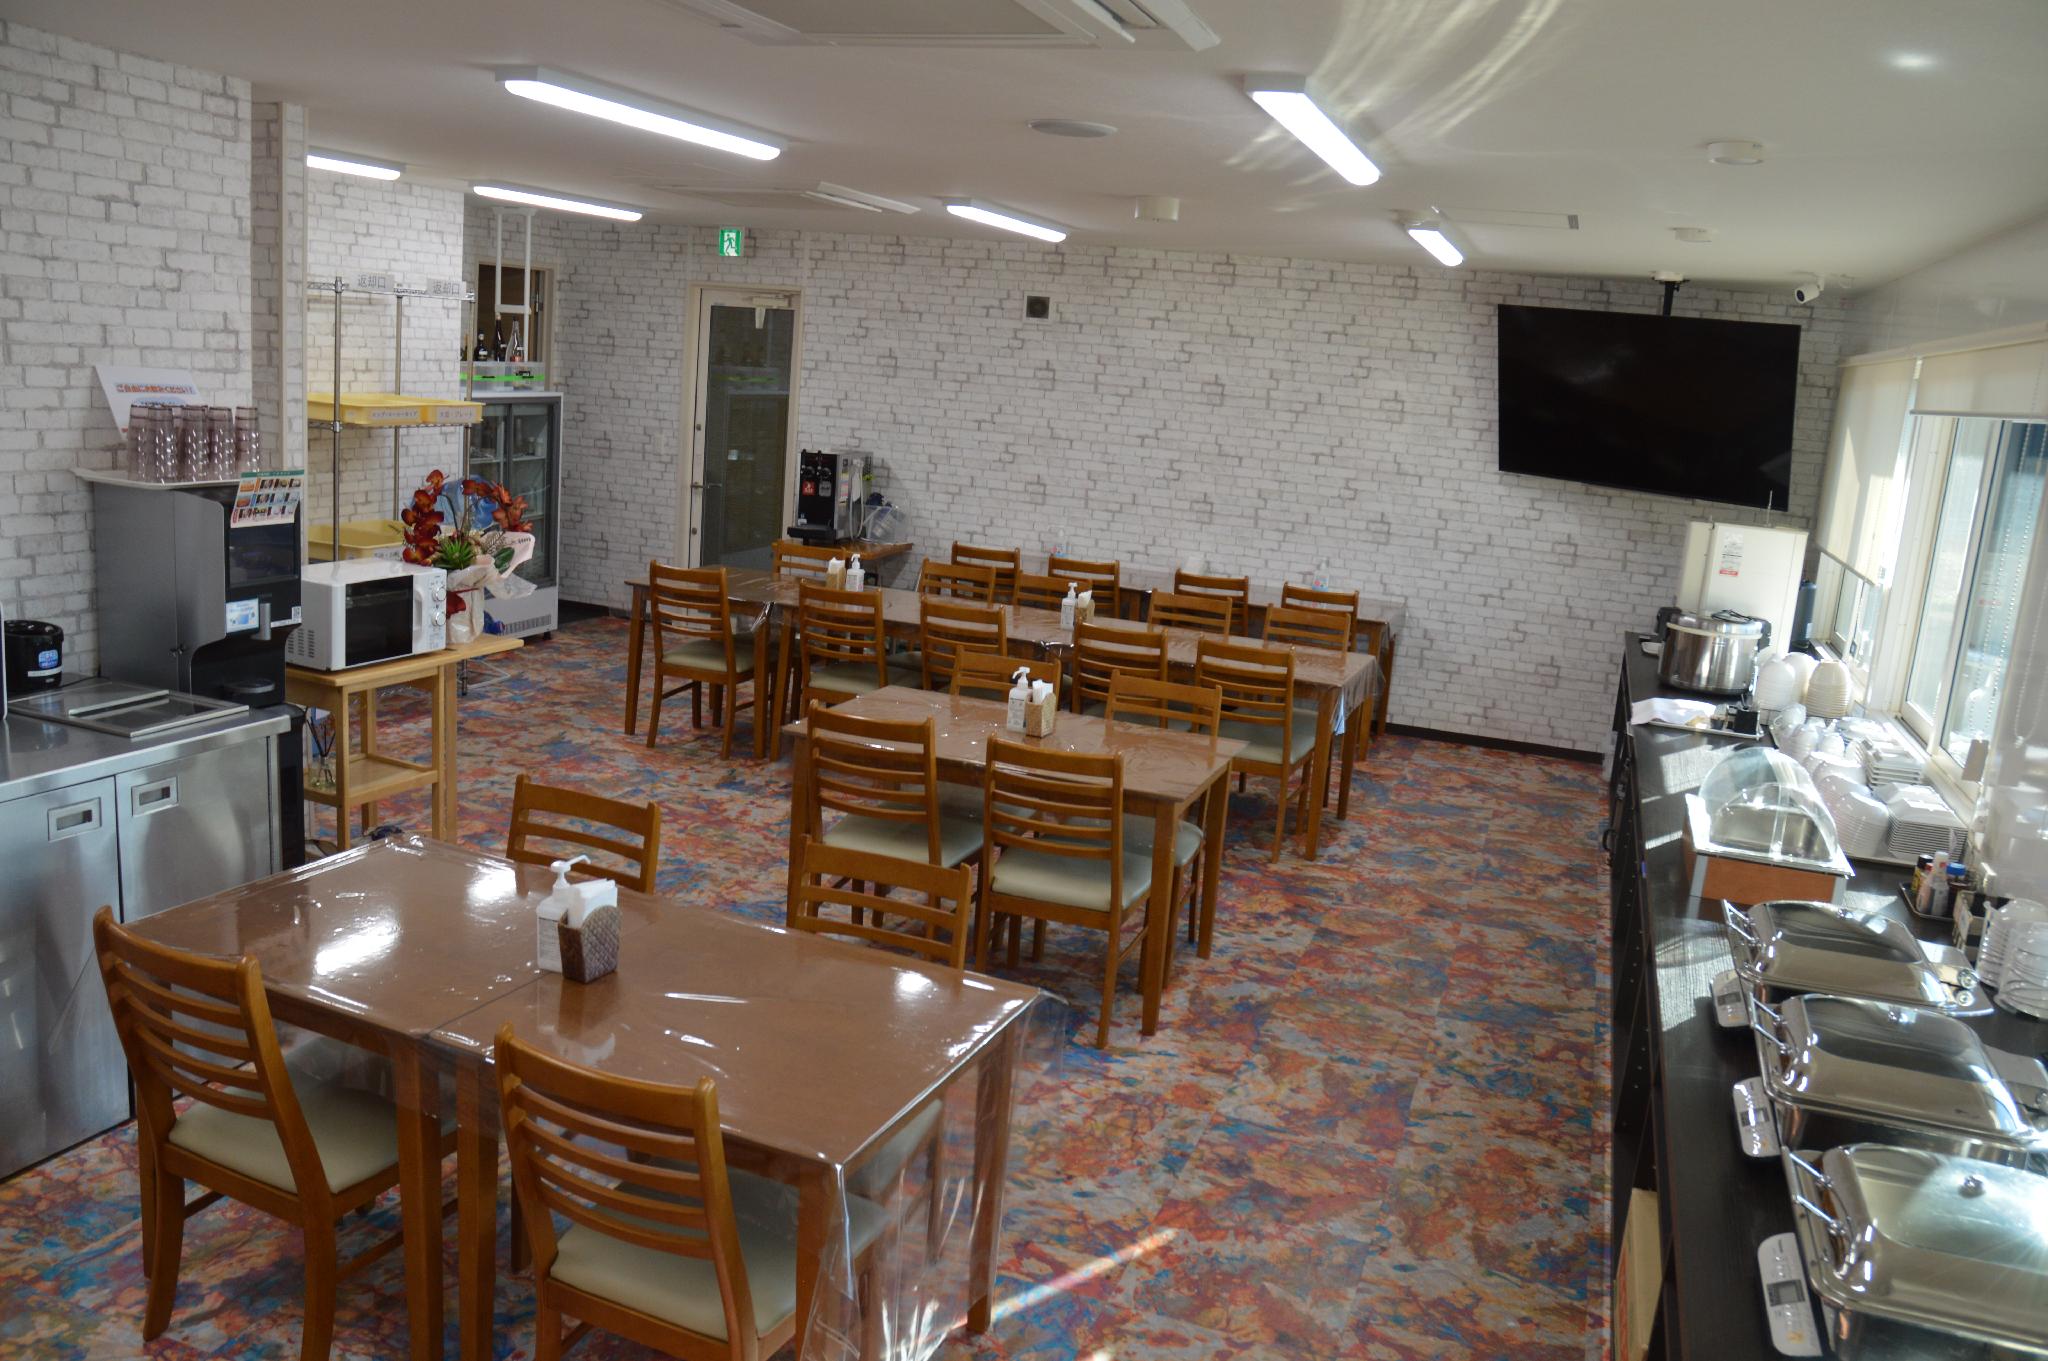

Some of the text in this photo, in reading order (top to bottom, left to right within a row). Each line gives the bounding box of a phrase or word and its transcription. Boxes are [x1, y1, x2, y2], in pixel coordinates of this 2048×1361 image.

[358, 274, 386, 288] 返却口
[433, 281, 460, 295] 返却口
